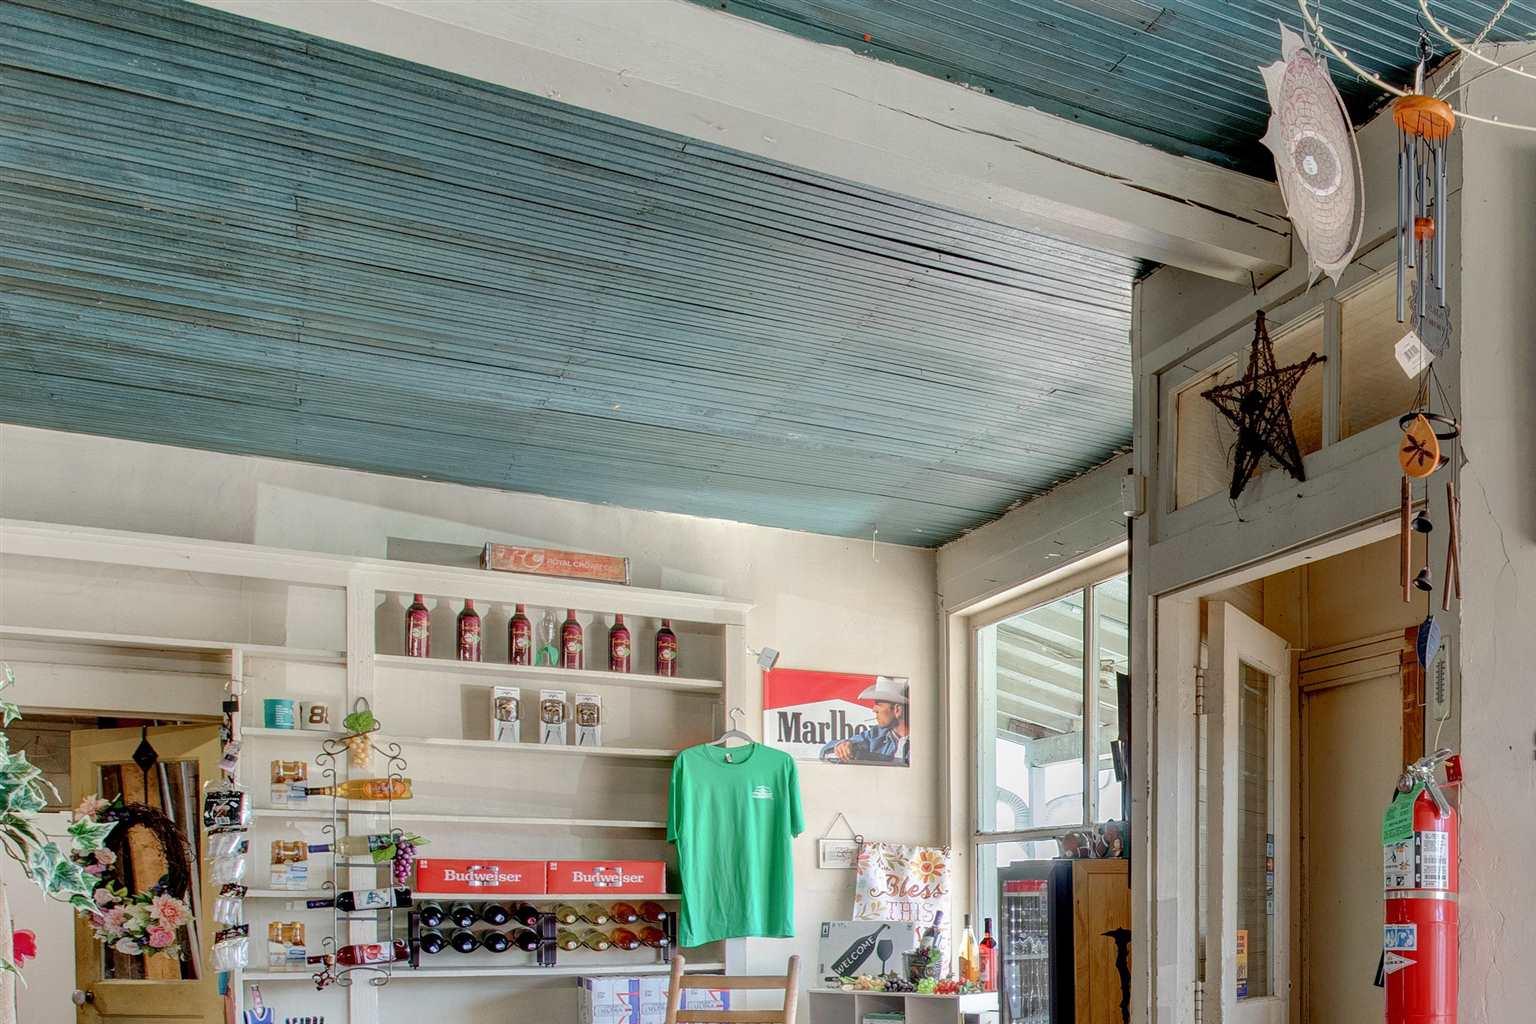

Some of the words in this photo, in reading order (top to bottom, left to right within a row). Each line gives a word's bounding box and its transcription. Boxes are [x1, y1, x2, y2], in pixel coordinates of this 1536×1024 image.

[443, 869, 522, 882] Budweiser
[572, 871, 645, 883] Budweiser
[869, 874, 949, 899] Bless
[886, 901, 936, 922] THIS
[834, 935, 876, 975] WELCOME
